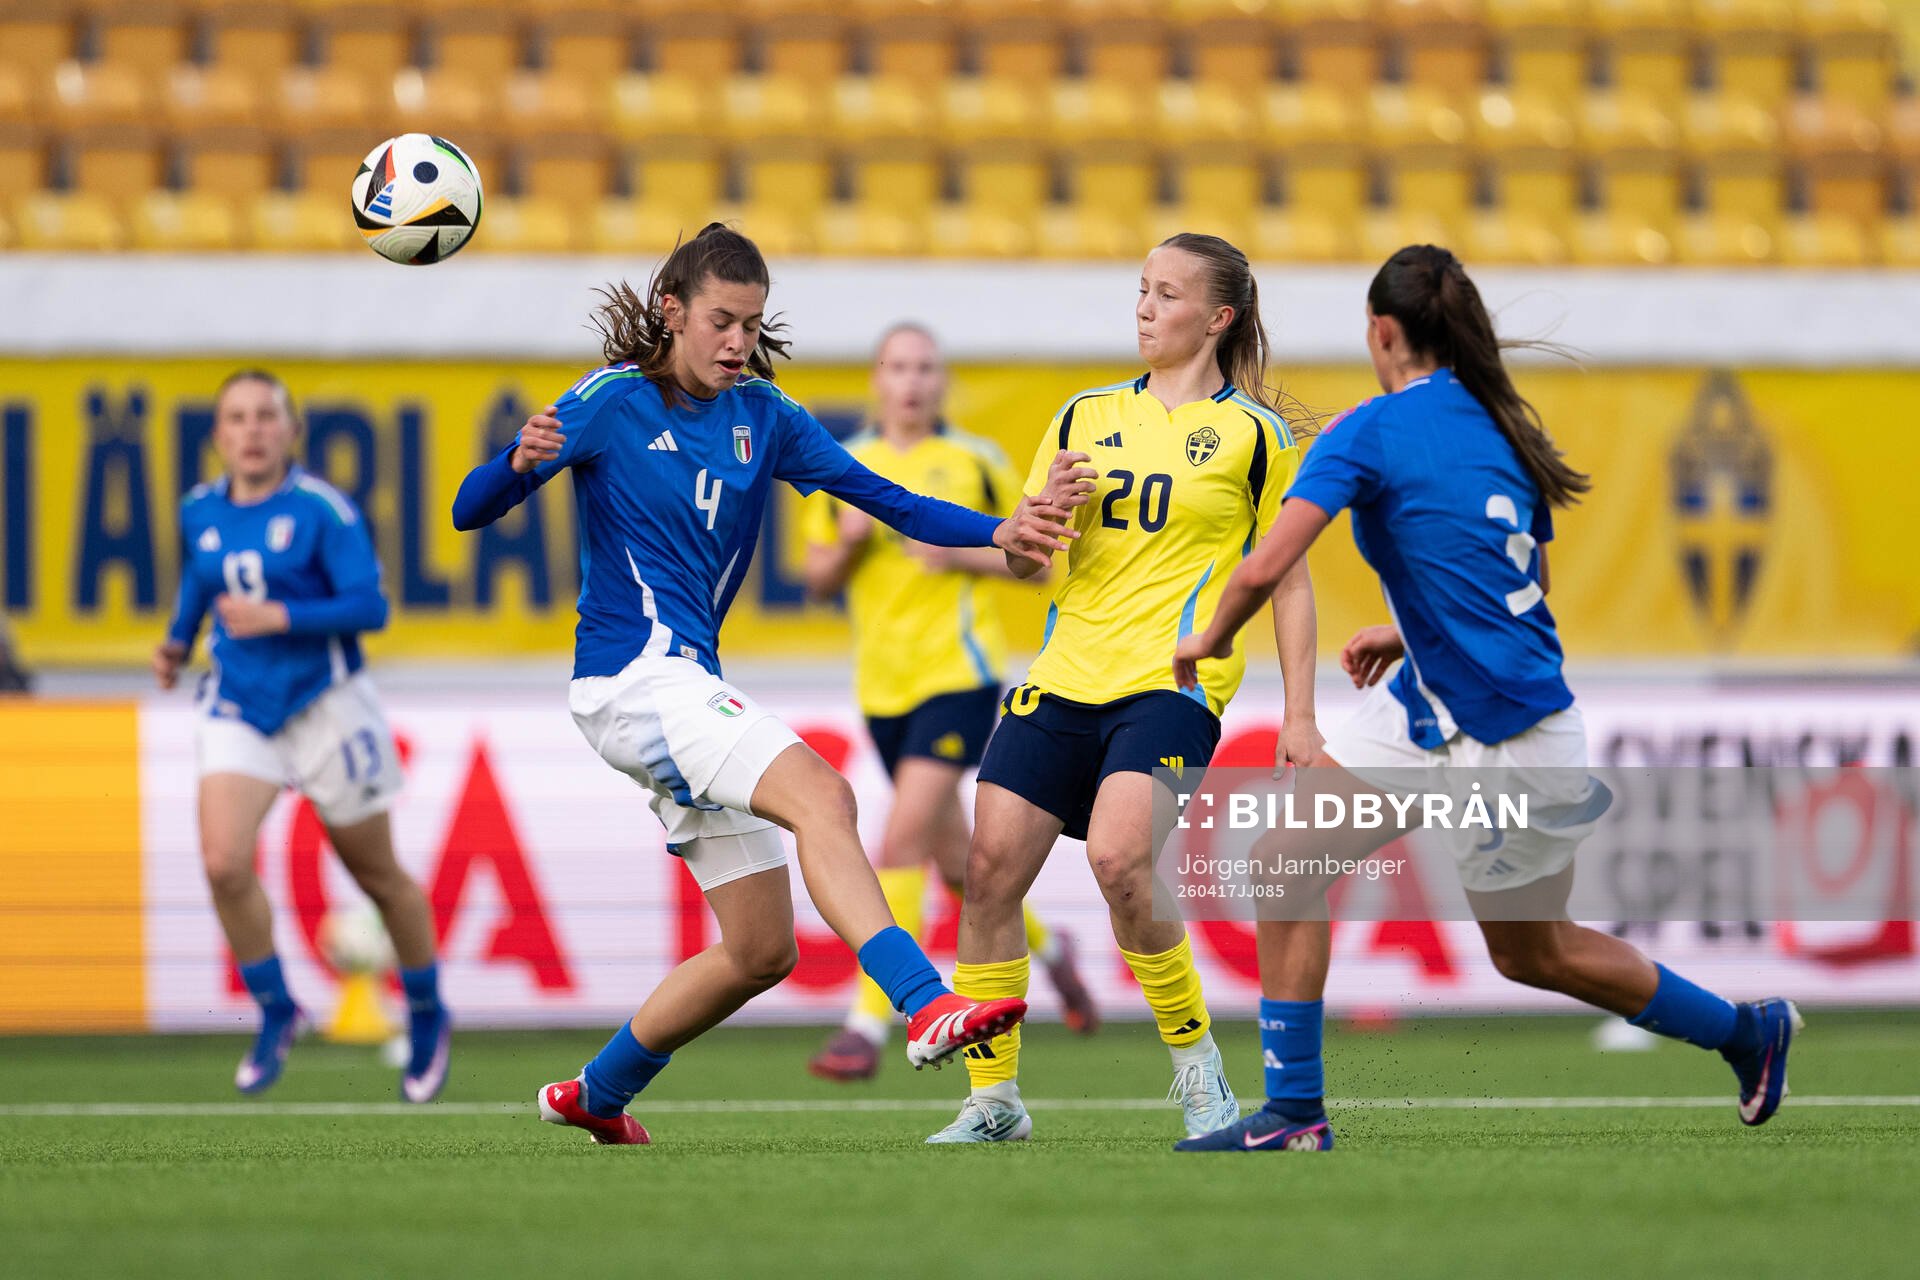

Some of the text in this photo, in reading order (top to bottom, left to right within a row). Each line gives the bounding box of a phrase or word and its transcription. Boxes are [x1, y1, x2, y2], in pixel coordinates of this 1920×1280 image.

[695, 468, 723, 530] 4
[1101, 469, 1173, 533] 20
[1485, 494, 1543, 617] 3
[341, 727, 382, 782] 13
